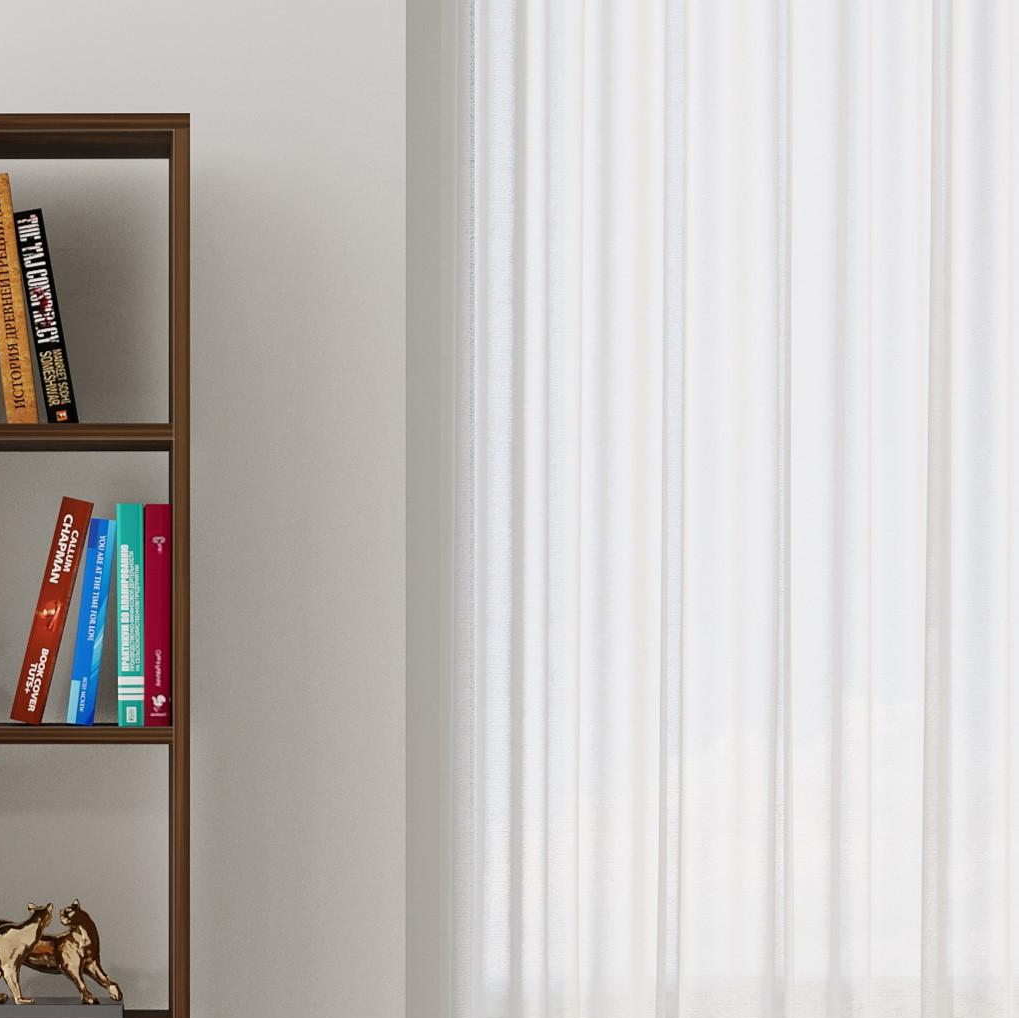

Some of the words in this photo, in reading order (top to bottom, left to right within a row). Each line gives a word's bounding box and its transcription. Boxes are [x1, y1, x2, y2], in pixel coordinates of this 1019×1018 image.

[17, 214, 41, 242] THE
[22, 242, 46, 268] TAJ
[8, 343, 26, 408] ИСТОРИЯ
[40, 350, 59, 406] SOMESHWAR
[49, 514, 73, 583] CHAPMAN
[63, 530, 79, 572] CALLUM
[98, 535, 106, 551] YOU
[95, 565, 103, 575] AT
[96, 552, 105, 565] ARE
[93, 576, 101, 590] THE
[91, 592, 99, 609] TIME
[89, 610, 97, 625] FOR
[38, 648, 49, 678] BOOK
[24, 663, 38, 694] TUTS+
[28, 678, 42, 712] COVER
